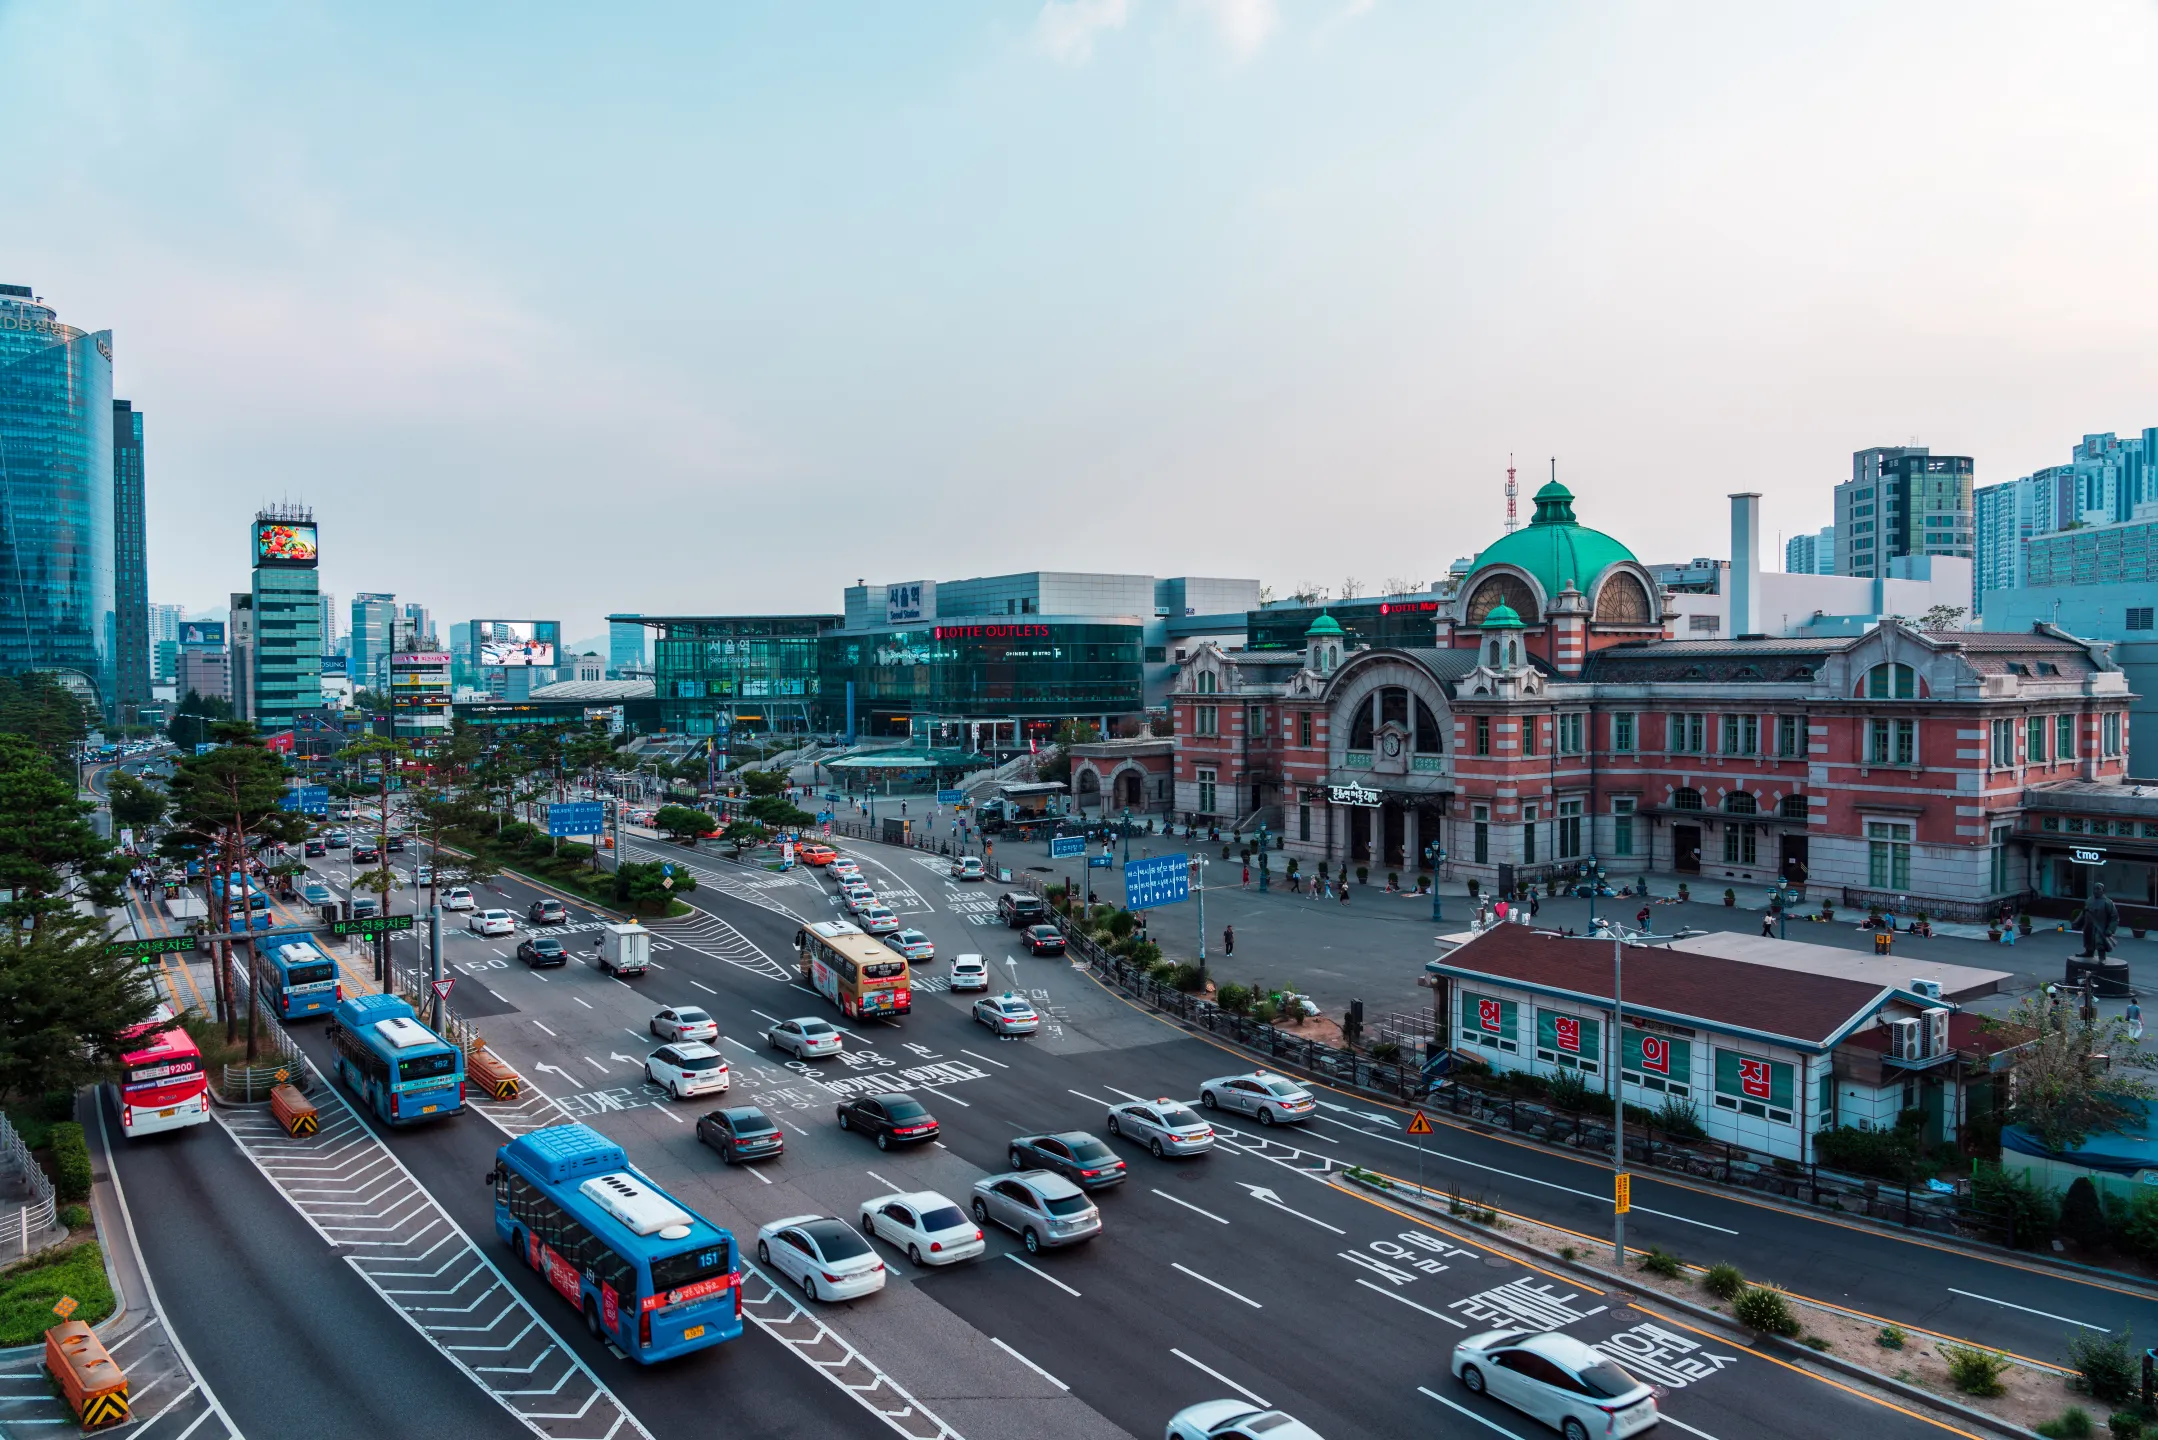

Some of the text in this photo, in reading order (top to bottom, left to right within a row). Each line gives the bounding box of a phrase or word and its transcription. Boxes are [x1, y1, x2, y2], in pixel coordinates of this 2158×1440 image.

[0, 316, 61, 336] DB생명
[890, 586, 920, 607] 서울역
[1391, 604, 1417, 612] LOTTE
[943, 624, 1049, 638] LOTTE OUTLETS
[709, 639, 750, 655] 서울역
[2076, 850, 2099, 860] tmo
[333, 917, 412, 935] 버스전용차로
[467, 959, 508, 971] 50
[1478, 998, 1772, 1101] 헌 혈 의 집
[170, 1063, 192, 1074] 9200
[434, 1060, 448, 1068] 162
[556, 1087, 648, 1117] 퇴계로
[700, 1252, 718, 1267] 151
[1337, 1230, 1480, 1286] 서울역
[586, 1267, 595, 1284] 151
